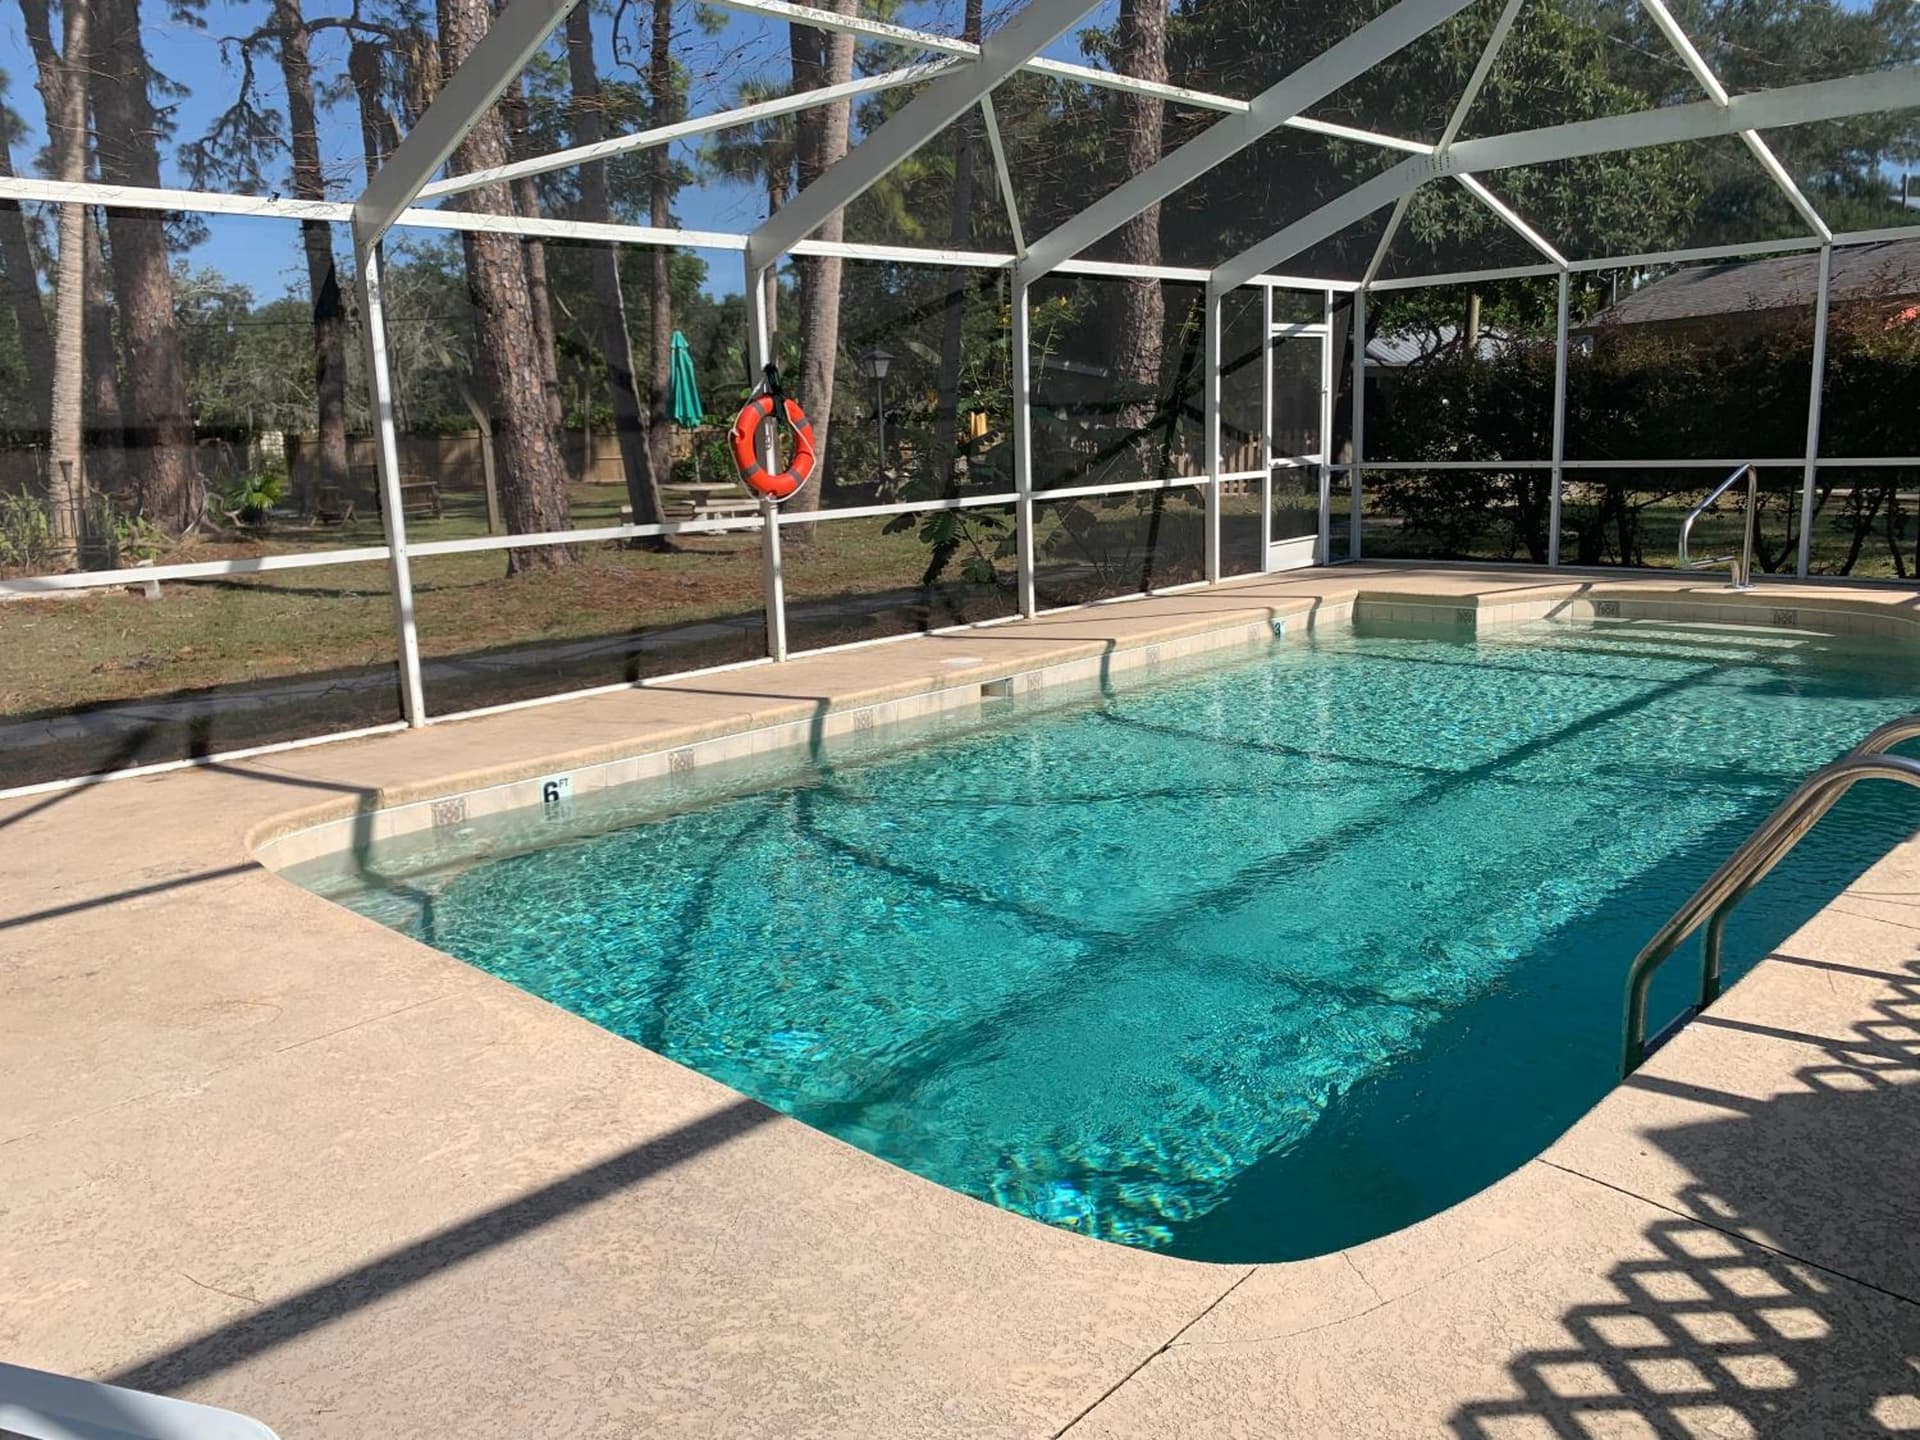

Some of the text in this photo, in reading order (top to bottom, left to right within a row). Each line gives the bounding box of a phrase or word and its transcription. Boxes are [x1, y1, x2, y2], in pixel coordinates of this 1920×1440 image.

[1274, 622, 1281, 639] 3
[543, 778, 568, 803] 6 FT
